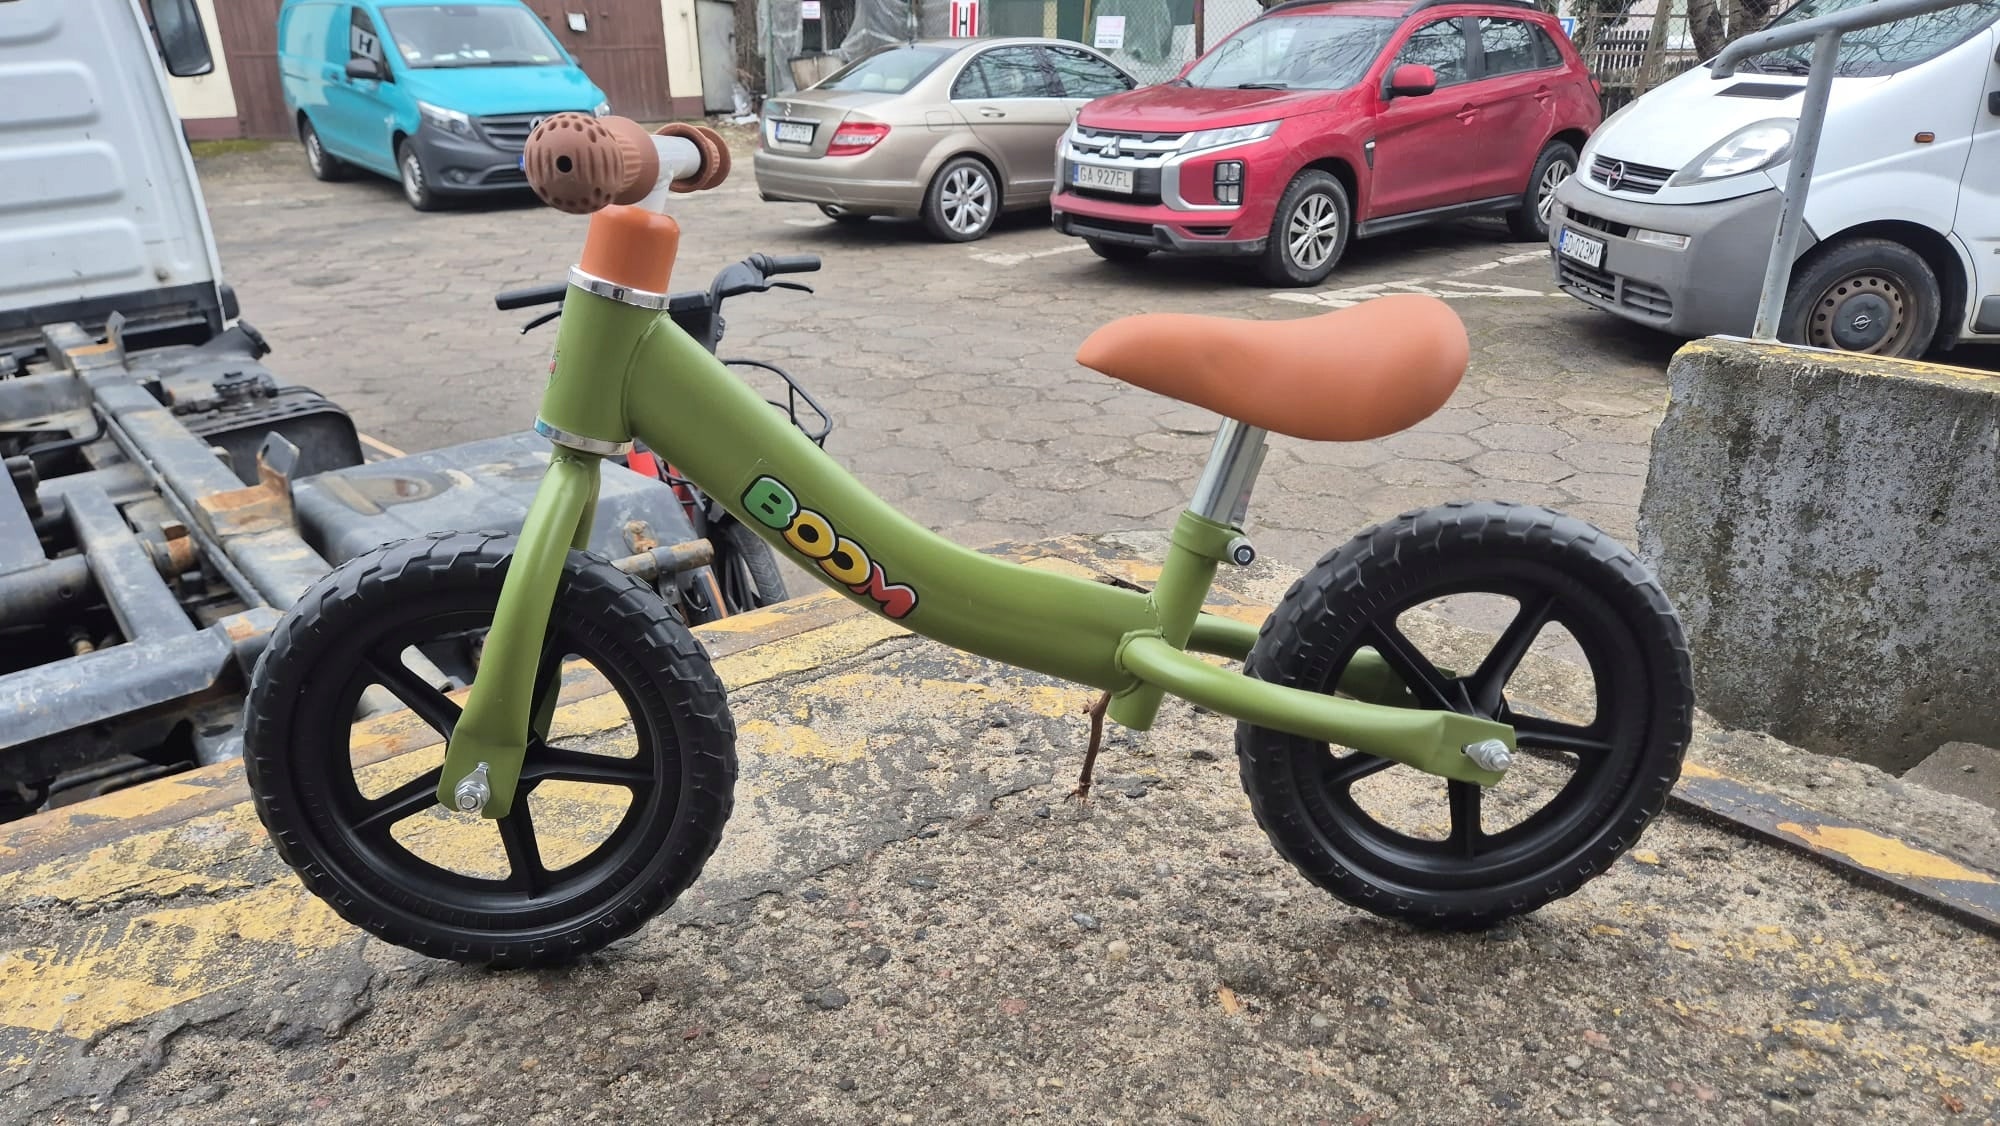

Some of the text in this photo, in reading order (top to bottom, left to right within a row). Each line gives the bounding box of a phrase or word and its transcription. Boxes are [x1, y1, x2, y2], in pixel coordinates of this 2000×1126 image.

[359, 34, 372, 54] H
[1080, 166, 1130, 187] GA 927FL
[741, 474, 919, 619] BOOM
